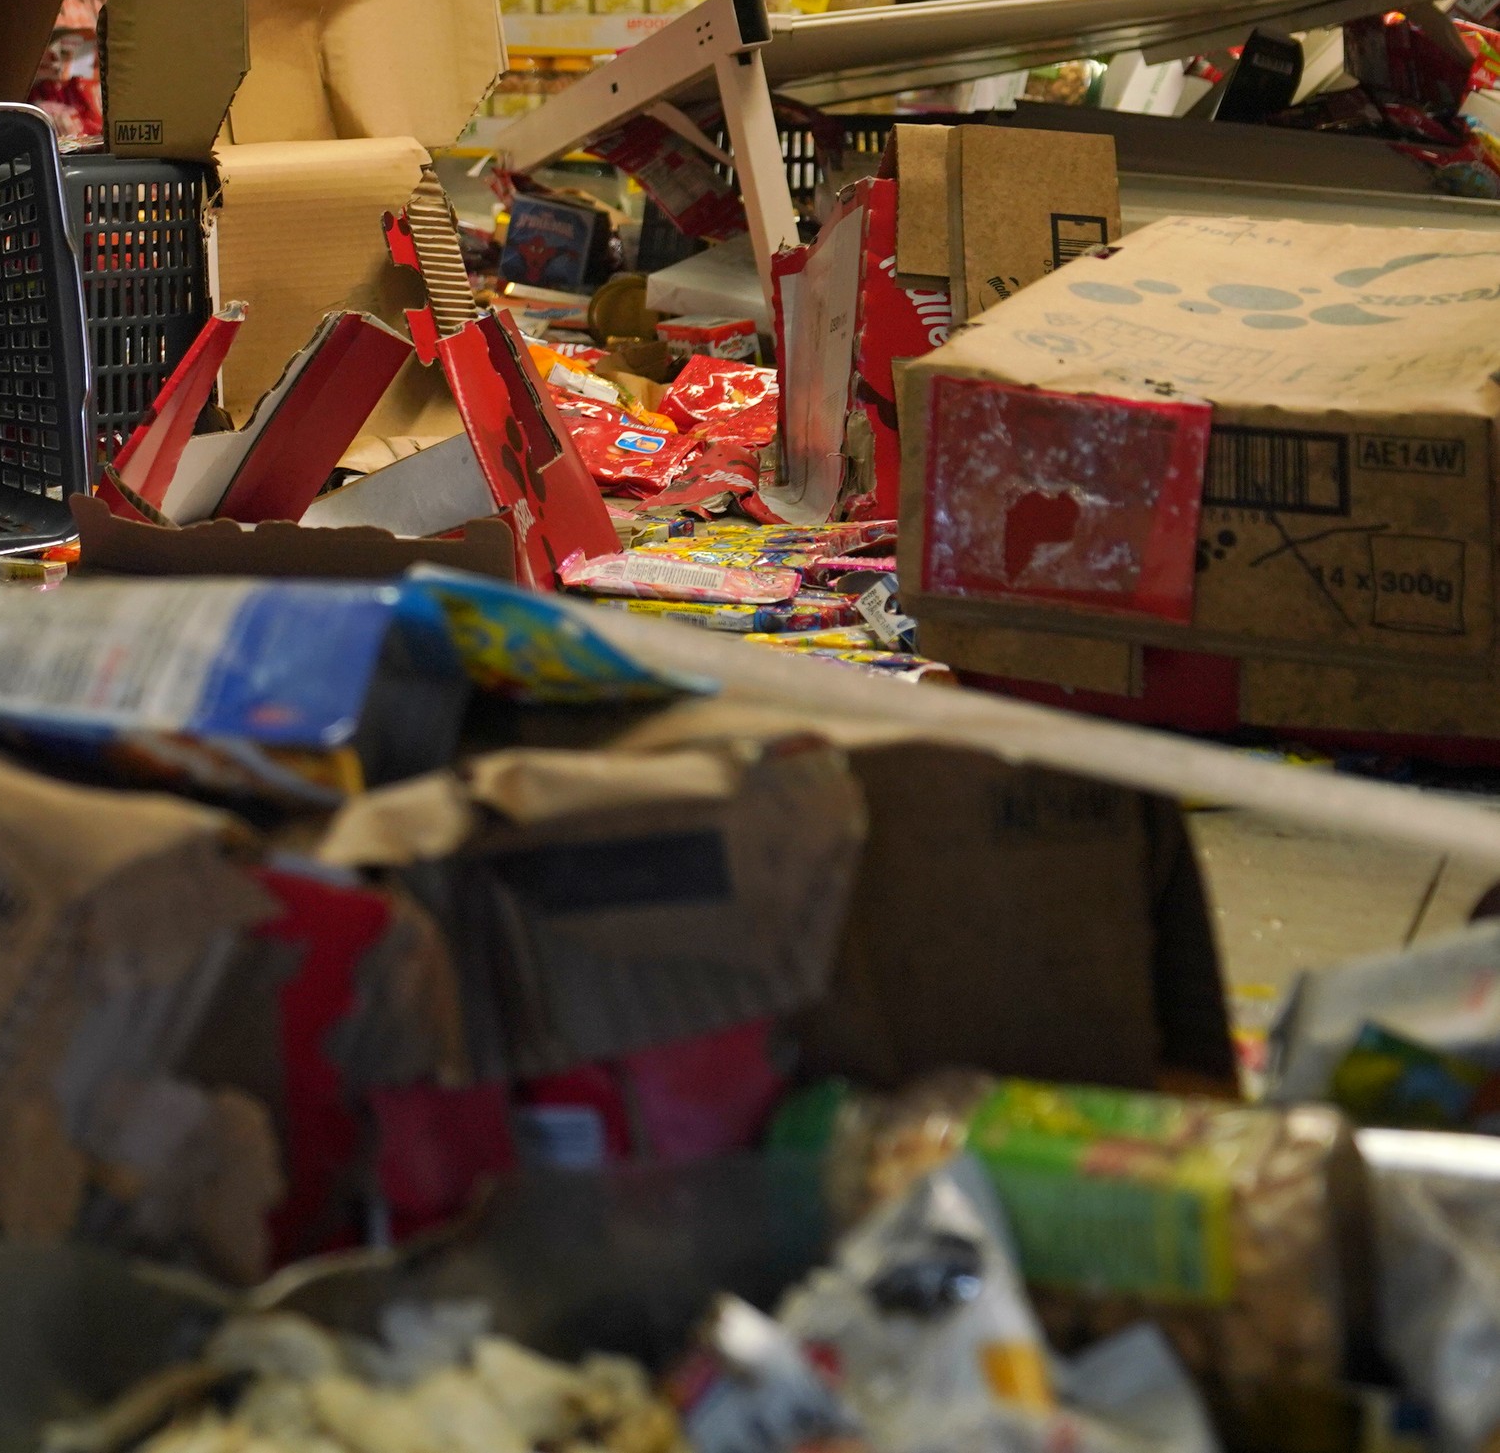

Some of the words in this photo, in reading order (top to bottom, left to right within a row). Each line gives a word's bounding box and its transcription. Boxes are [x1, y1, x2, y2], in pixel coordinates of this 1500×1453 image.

[117, 123, 161, 141] AE14W
[1363, 439, 1458, 469] AE14W
[1381, 569, 1452, 604] 300g
